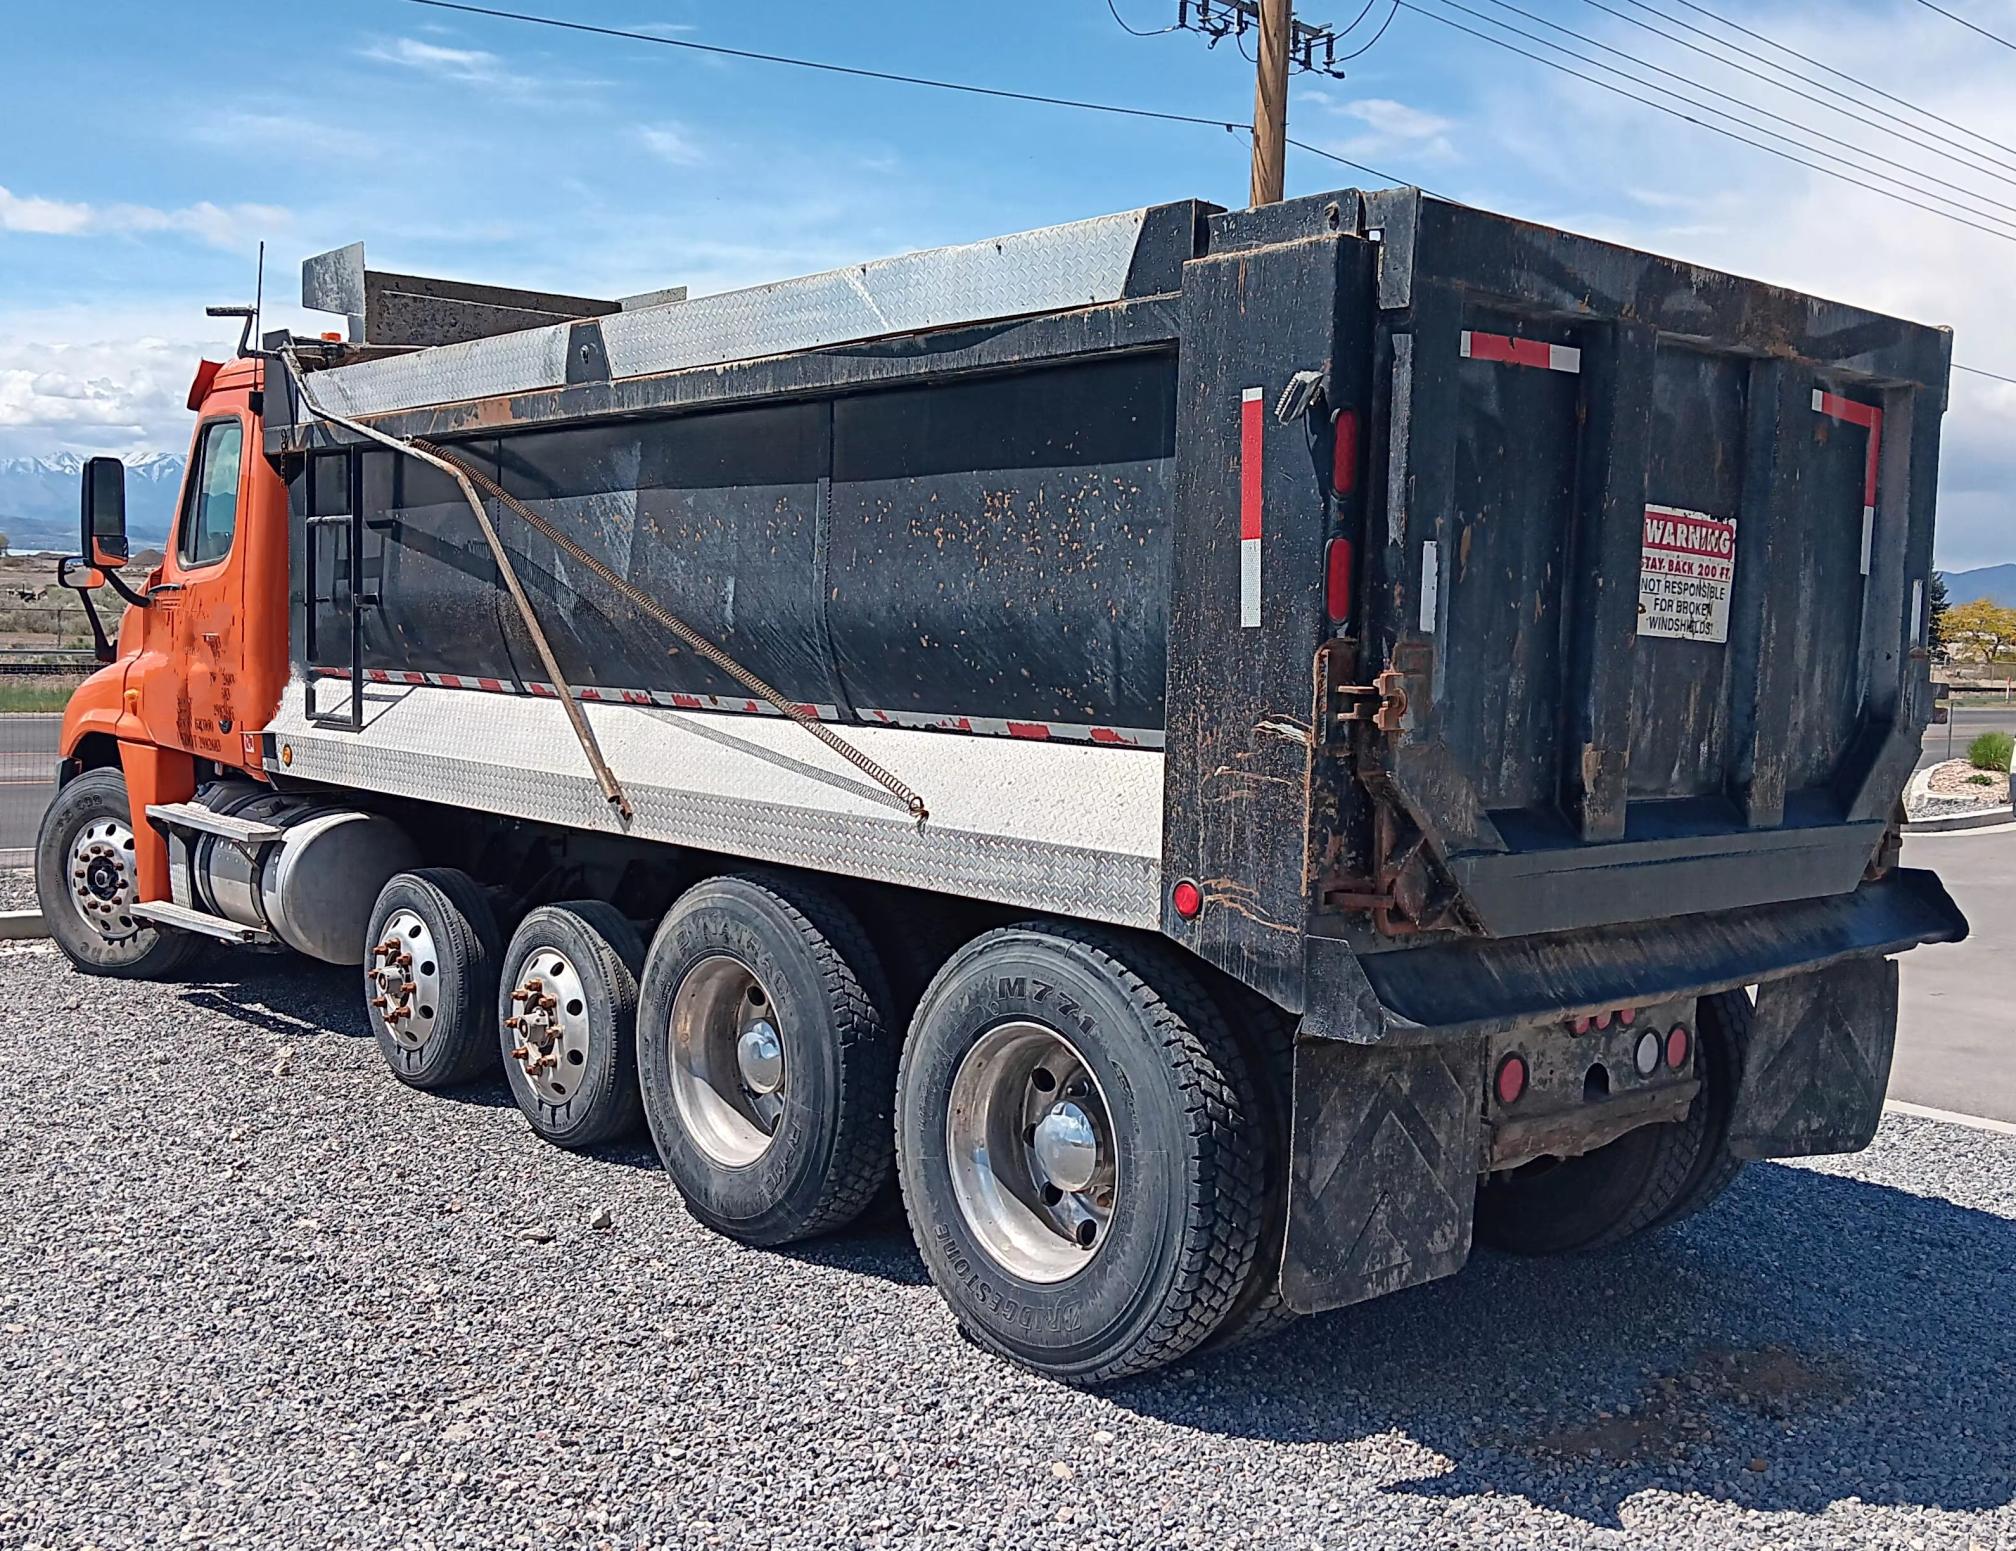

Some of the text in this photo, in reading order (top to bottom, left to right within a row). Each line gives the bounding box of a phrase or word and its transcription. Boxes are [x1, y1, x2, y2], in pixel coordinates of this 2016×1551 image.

[1645, 518, 1731, 554] WARNING
[1668, 559, 1694, 575] BACK
[1697, 563, 1717, 577] 200
[1641, 577, 1726, 601] NOT RESPONSIBLE
[1654, 598, 1713, 617] FOR BROKEN
[997, 975, 1098, 1037] M771
[934, 1222, 1082, 1333] BRIDGESTONE
